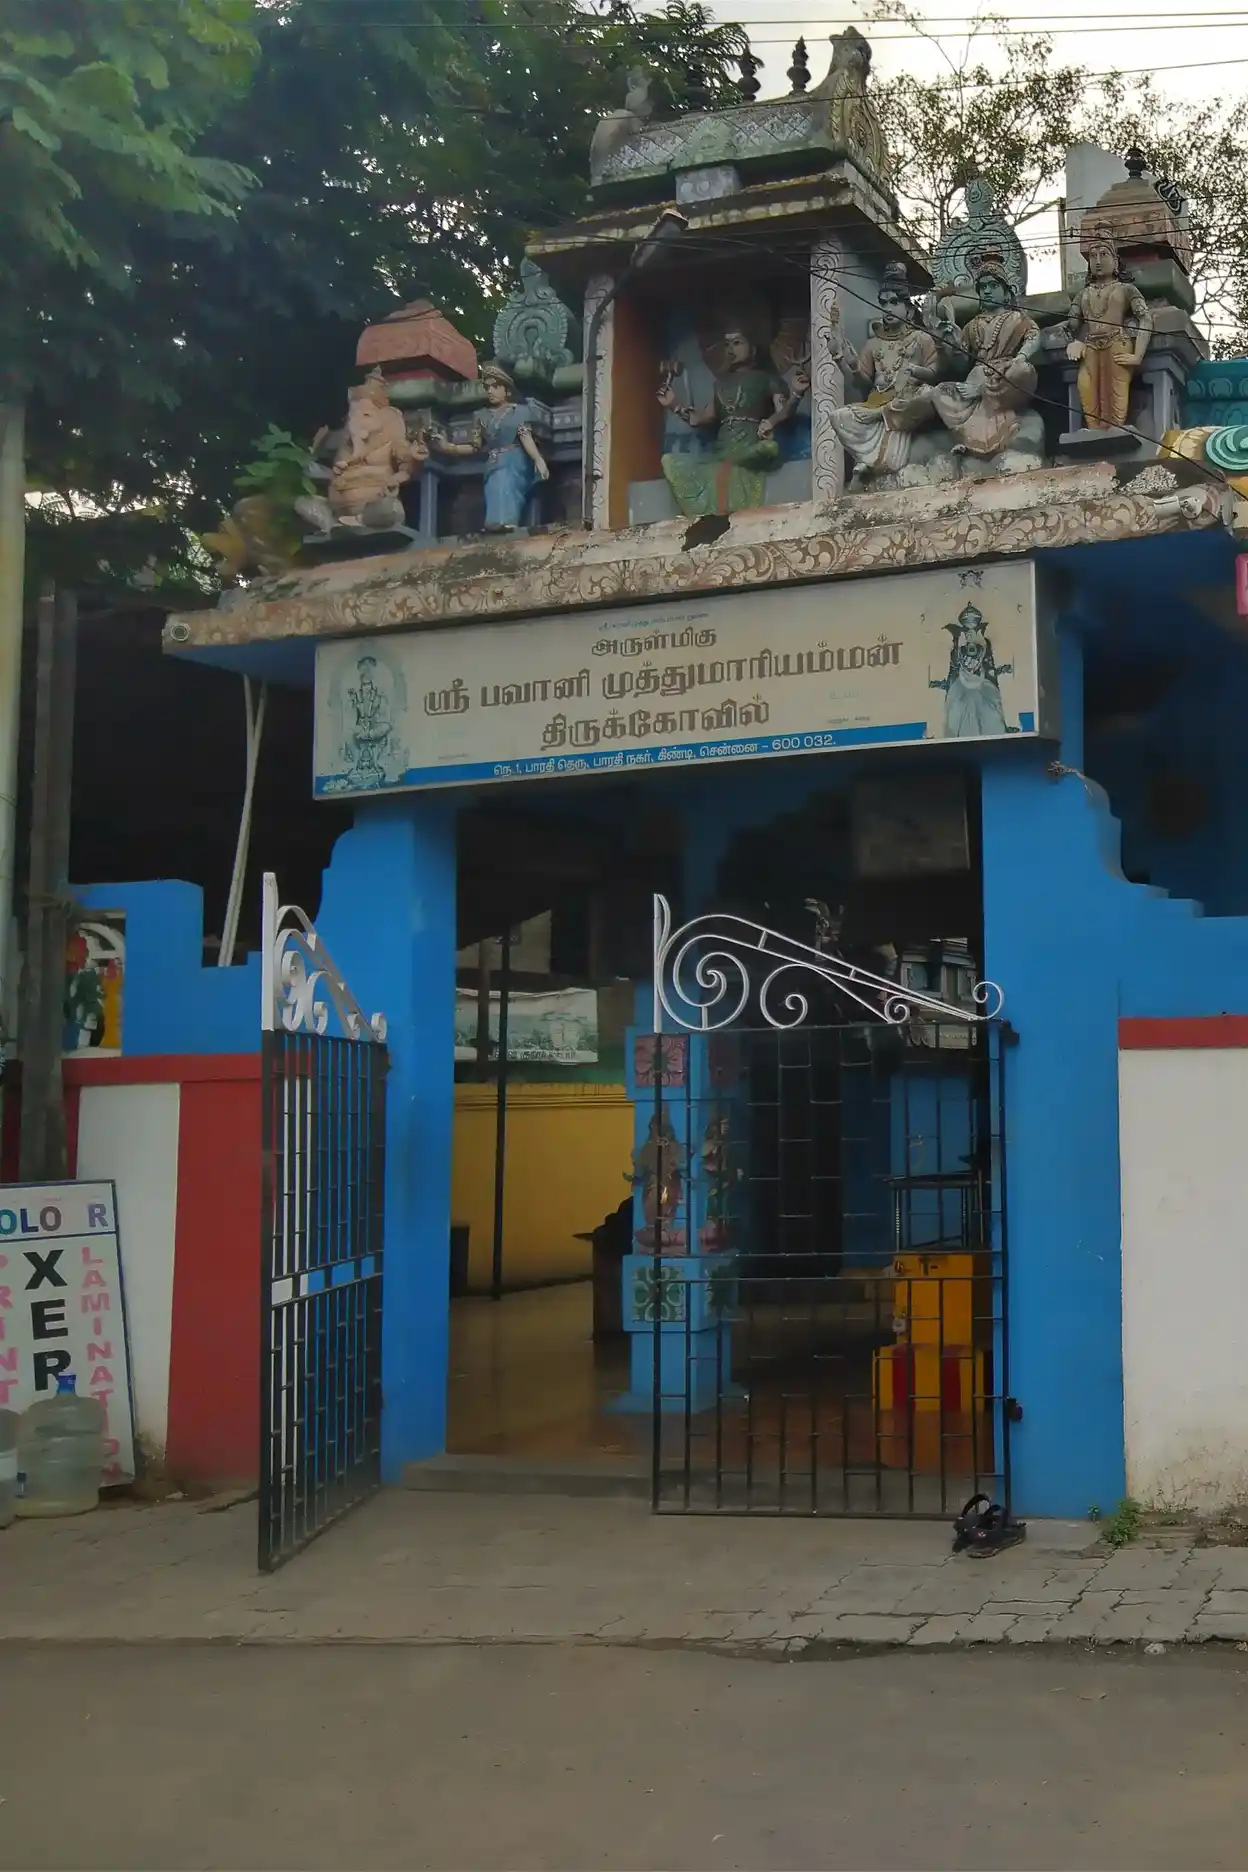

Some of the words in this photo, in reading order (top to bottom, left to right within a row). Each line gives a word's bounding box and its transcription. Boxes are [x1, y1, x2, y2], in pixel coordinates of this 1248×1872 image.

[592, 626, 717, 657] அருள்மிகு
[481, 669, 590, 708] பவானி
[602, 633, 903, 700] முத்துமாரியம்மன்
[540, 693, 769, 751] திருக்கோவில்
[525, 758, 554, 773] பாரதி
[593, 752, 623, 767] பாரதி
[700, 742, 758, 756] சென்னை
[772, 737, 801, 750] 600
[804, 734, 836, 748] 032.
